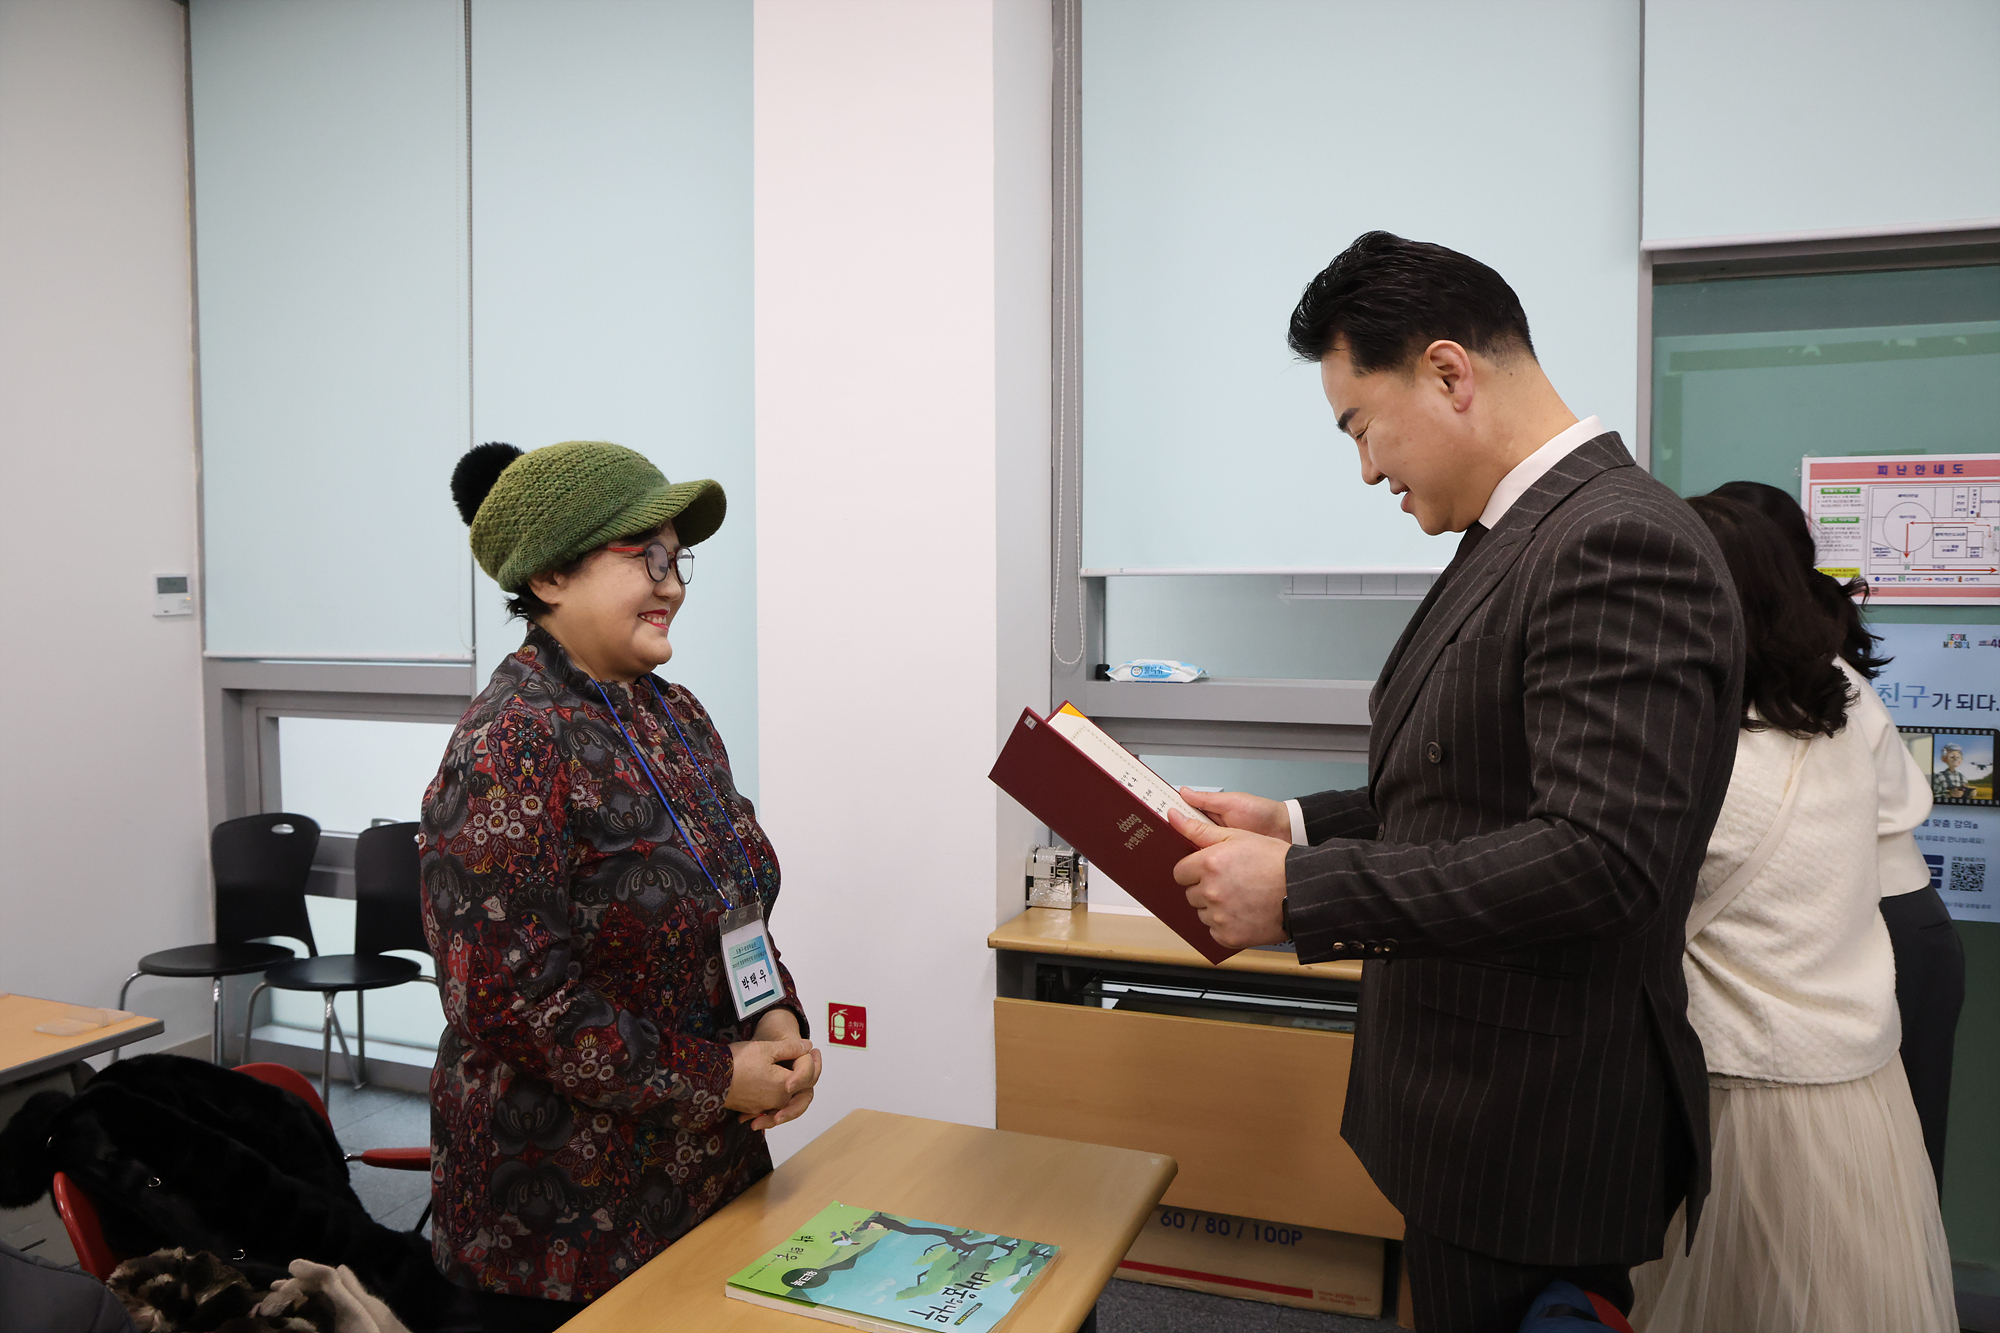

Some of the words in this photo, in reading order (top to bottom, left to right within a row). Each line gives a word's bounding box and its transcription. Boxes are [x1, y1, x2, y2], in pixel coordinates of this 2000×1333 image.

[1876, 681, 1952, 710] 친구가
[1956, 693, 2000, 711] 되다.
[1116, 813, 1142, 833] dobong
[1160, 1210, 1185, 1229] 60
[1205, 1217, 1230, 1236] 80
[1253, 1224, 1303, 1246] 100P
